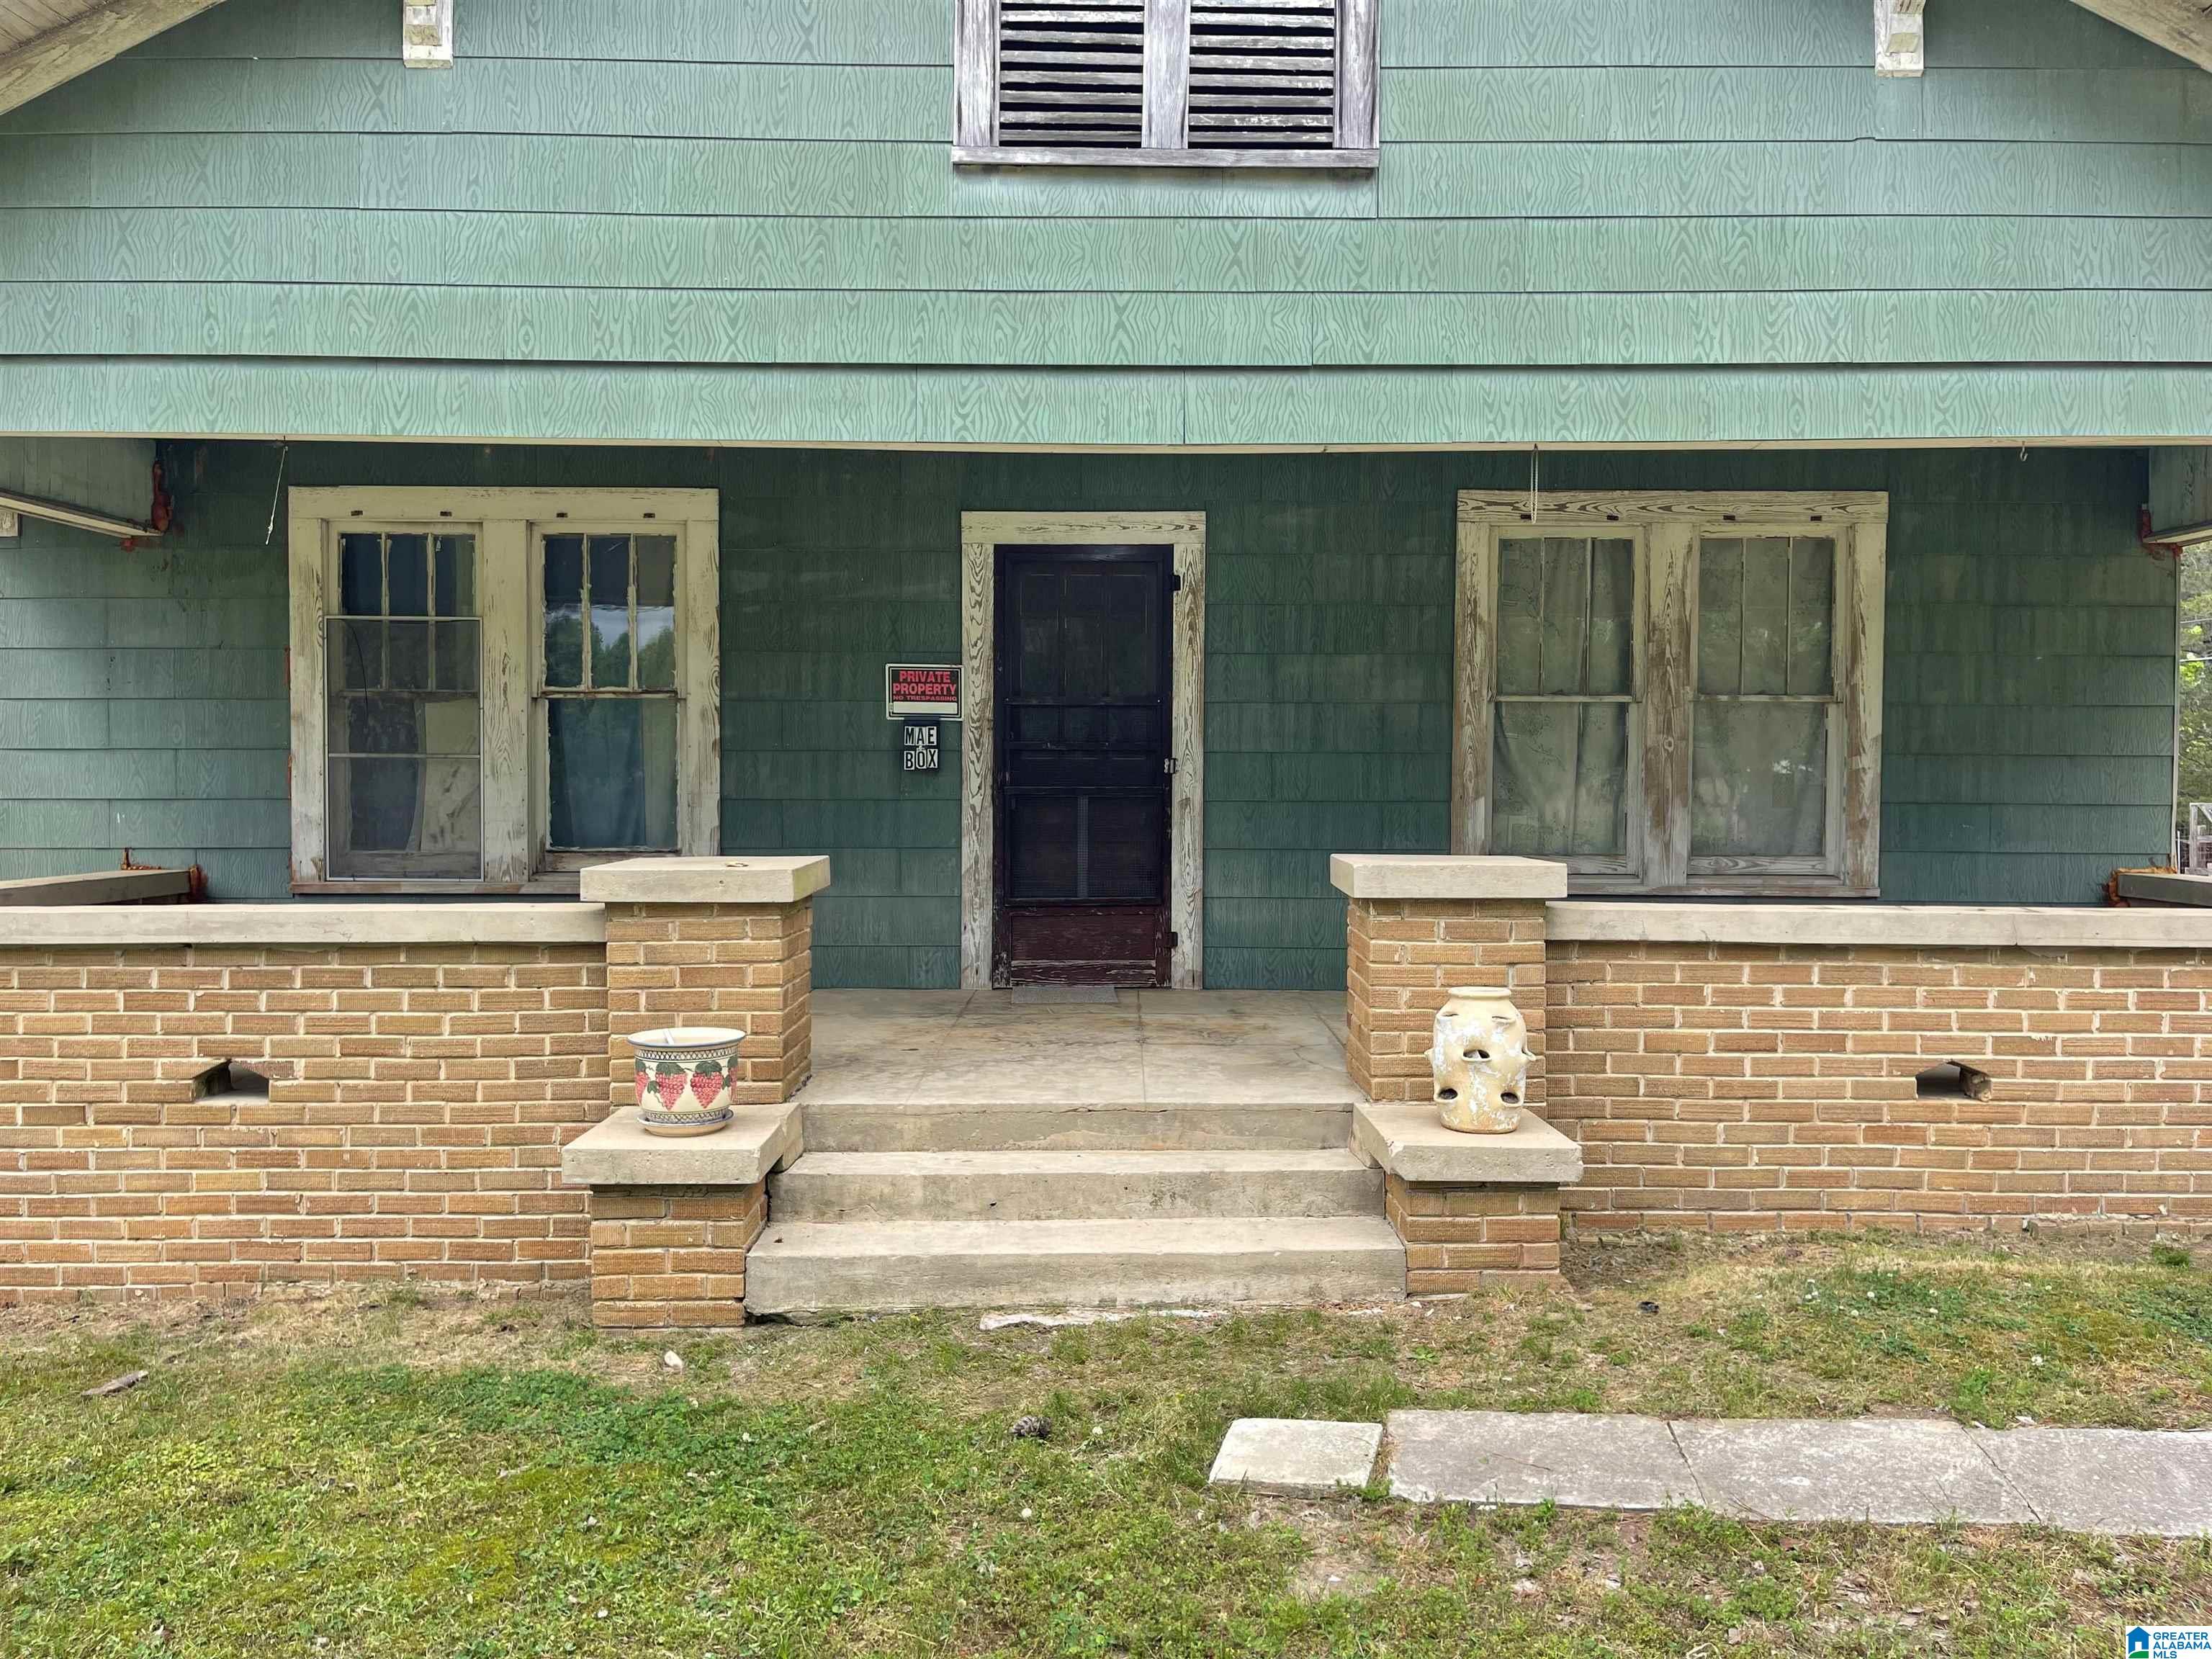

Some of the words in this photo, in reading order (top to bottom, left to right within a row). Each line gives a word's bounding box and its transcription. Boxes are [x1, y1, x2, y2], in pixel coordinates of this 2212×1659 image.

[899, 670, 950, 683] PRIVATE
[893, 683, 957, 695] PROPERTY
[905, 727, 935, 745] MAE
[905, 750, 937, 768] BOX
